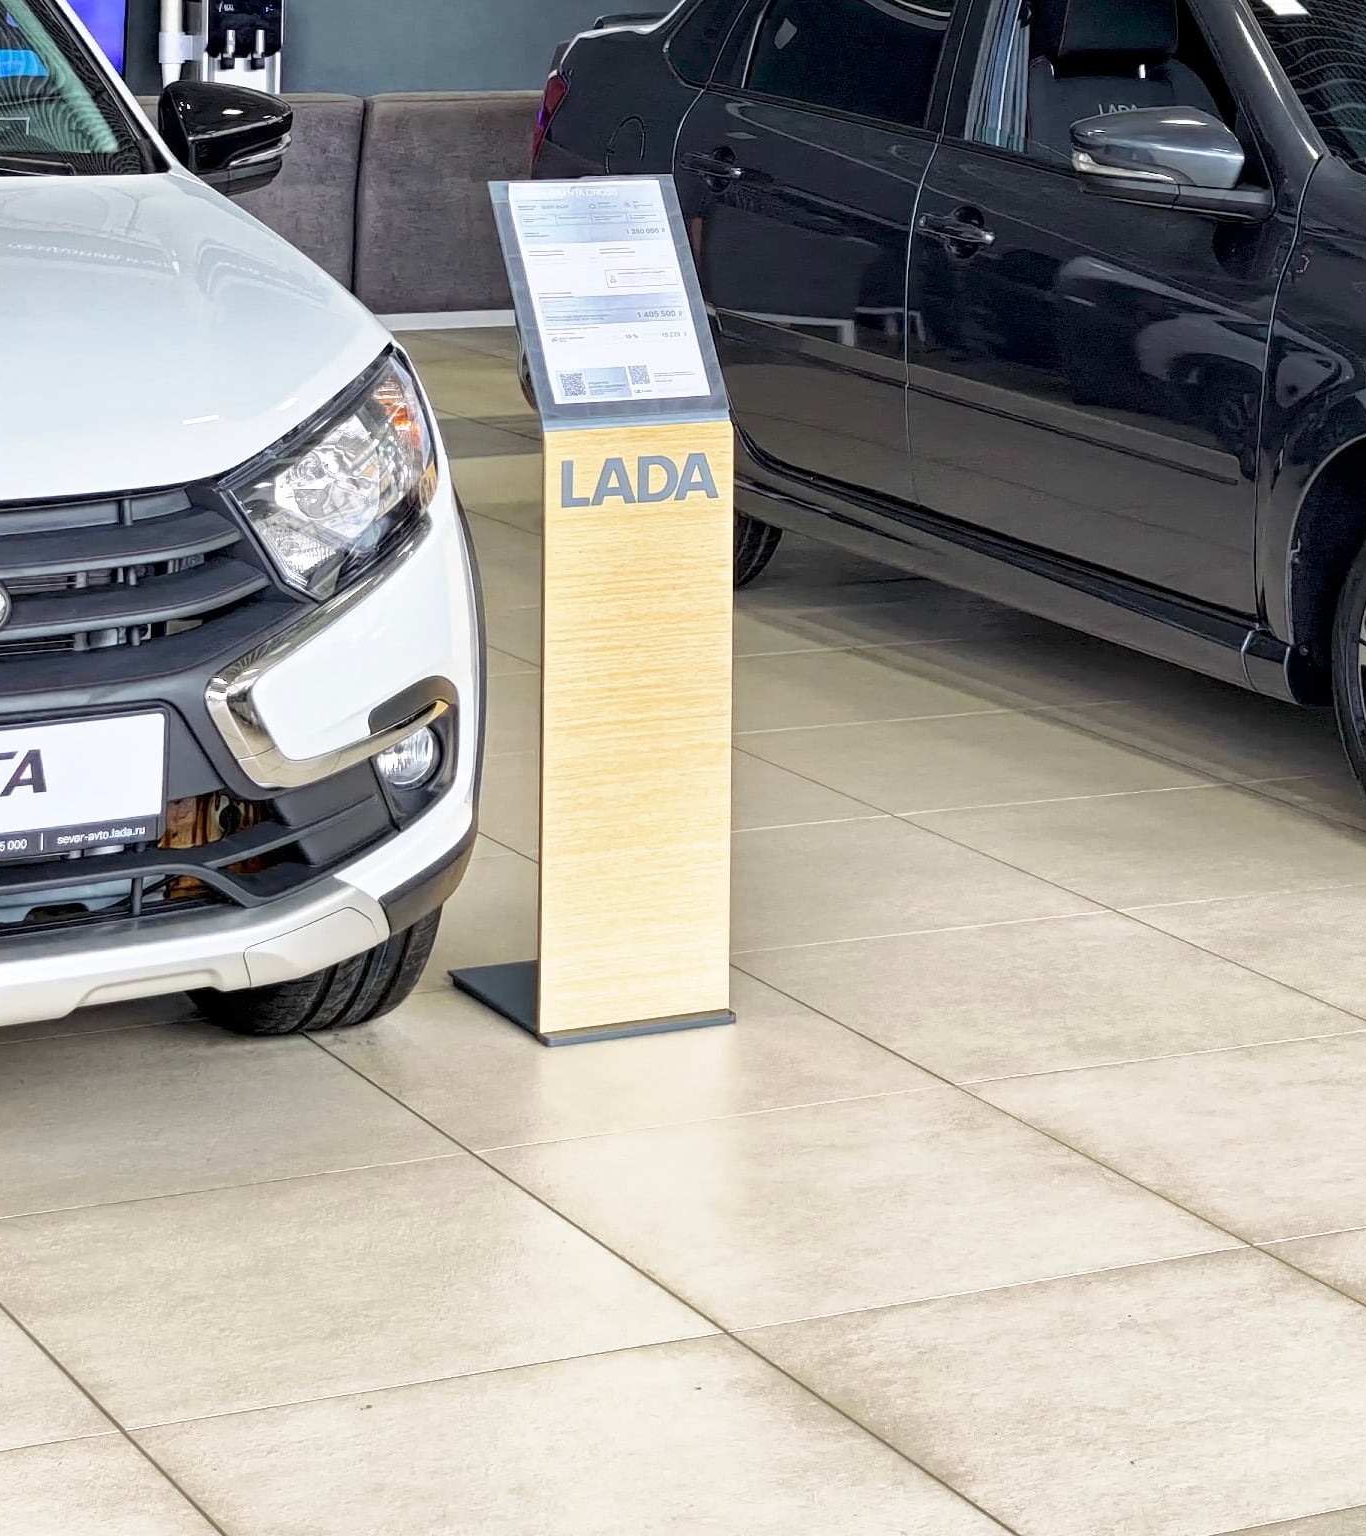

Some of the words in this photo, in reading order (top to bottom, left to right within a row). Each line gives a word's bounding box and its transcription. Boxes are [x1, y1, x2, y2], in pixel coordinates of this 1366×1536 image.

[561, 452, 718, 508] LADA
[7, 838, 28, 851] 000
[56, 826, 146, 845] sever-avto.lada.ru
